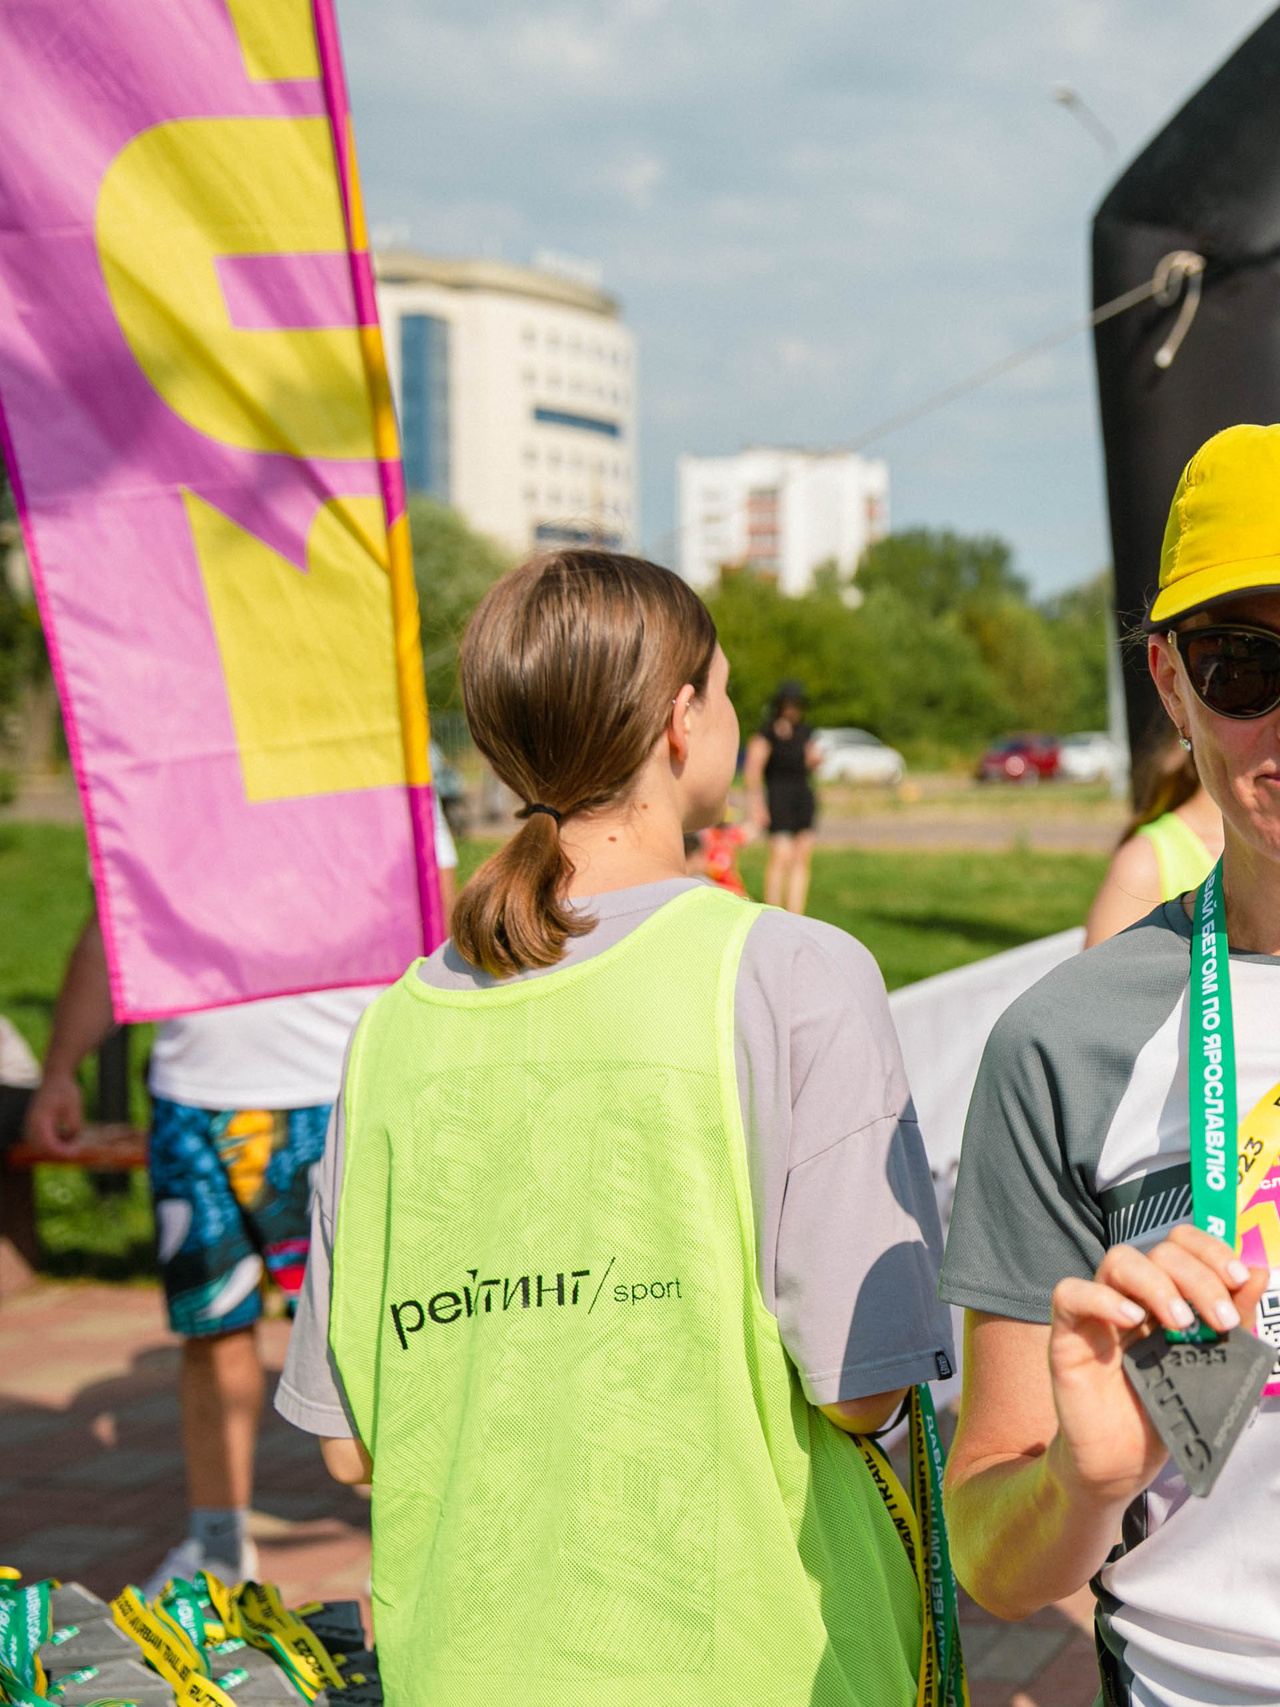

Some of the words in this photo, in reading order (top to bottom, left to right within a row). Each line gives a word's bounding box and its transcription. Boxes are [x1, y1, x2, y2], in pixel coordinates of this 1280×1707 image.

[1201, 919, 1219, 995] БЕГОМ
[1202, 998, 1221, 1031] ПО
[1203, 1035, 1226, 1192] ЯРОСЛАВЛЮ
[613, 1277, 683, 1306] sport
